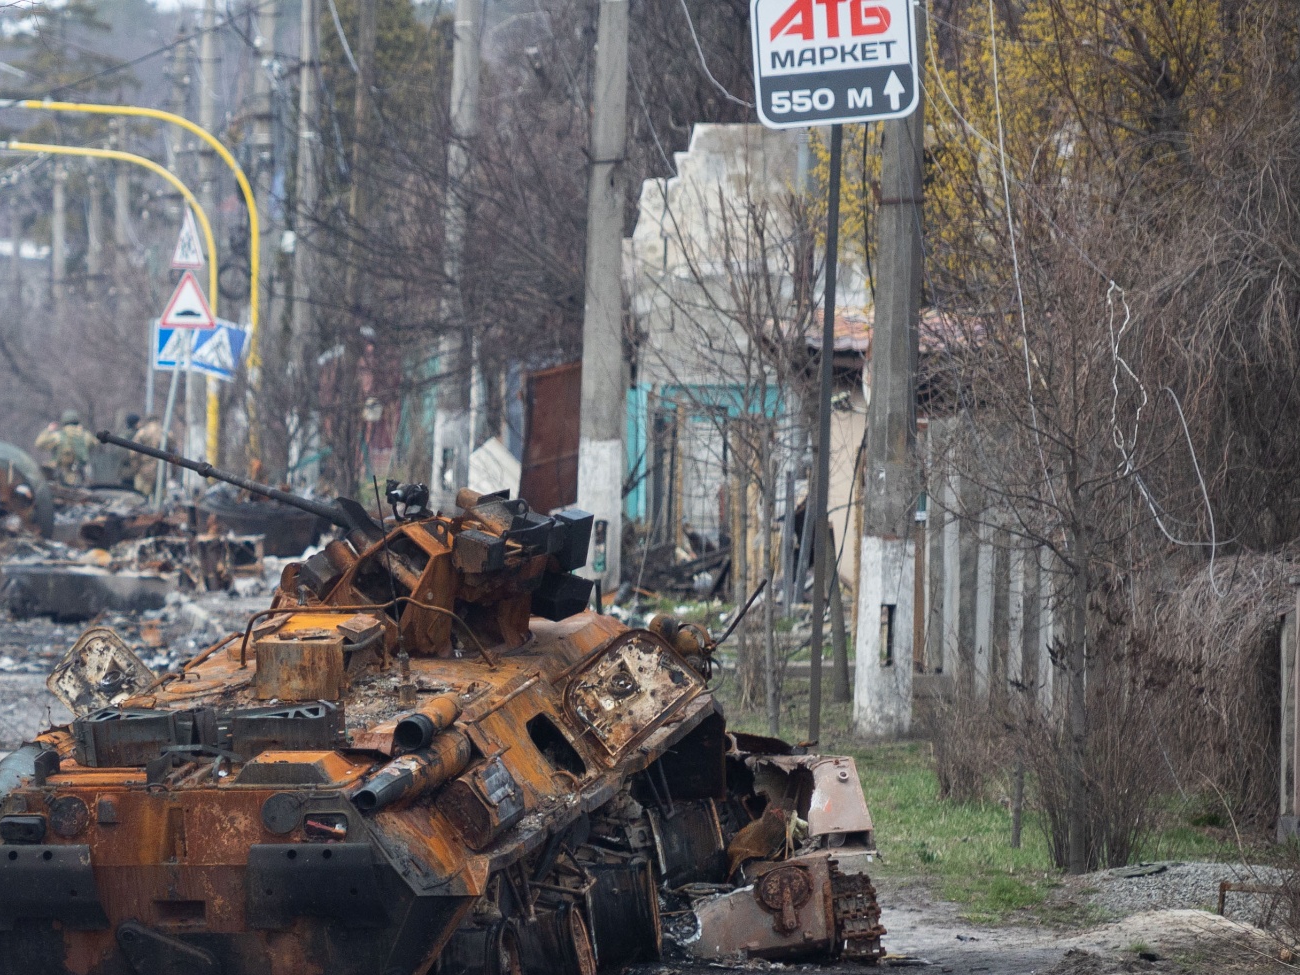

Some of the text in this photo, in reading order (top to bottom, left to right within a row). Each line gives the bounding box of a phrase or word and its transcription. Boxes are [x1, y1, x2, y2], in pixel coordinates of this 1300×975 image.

[770, 0, 892, 42] АТБ
[770, 40, 897, 69] МАРКЕТ
[771, 87, 835, 114] 550
